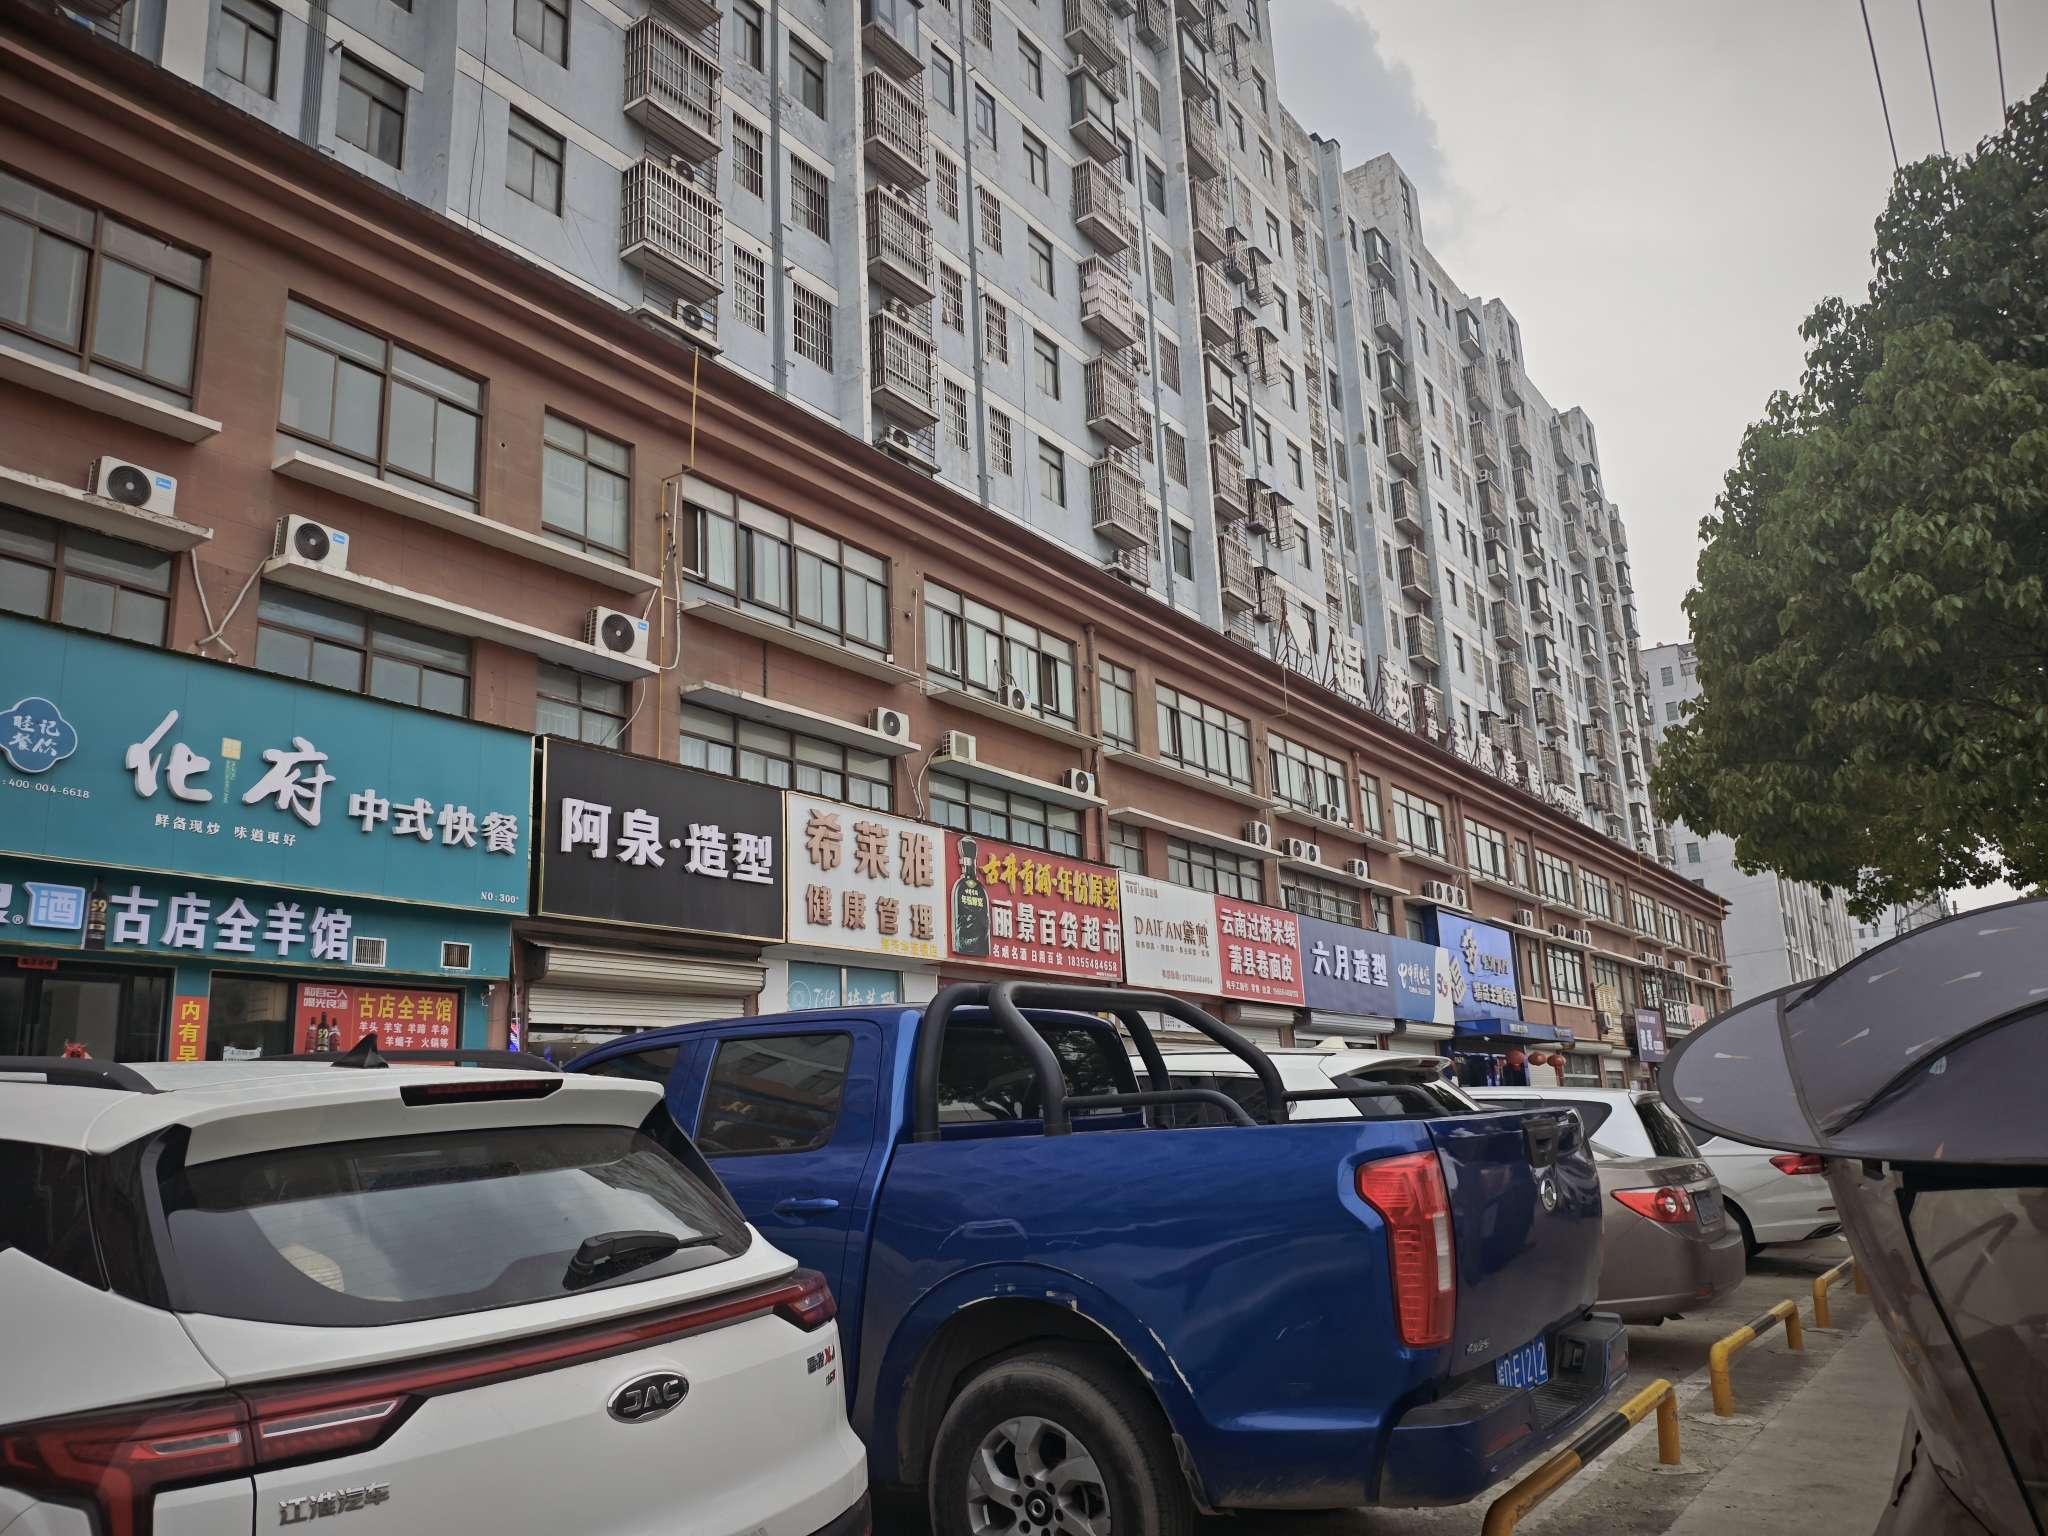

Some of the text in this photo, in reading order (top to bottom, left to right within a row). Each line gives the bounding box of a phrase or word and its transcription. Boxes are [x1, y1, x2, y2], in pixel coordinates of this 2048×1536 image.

[234, 826, 297, 847] 味道更好
[348, 789, 519, 856] 中式快餐
[561, 797, 774, 885] 阿泉·造型
[806, 808, 934, 888] 希莱雅
[38, 889, 77, 924] 酒
[109, 885, 352, 962] 古店全羊馆
[806, 884, 934, 941] 健康管理
[991, 899, 1120, 955] 丽景百货超市
[1219, 907, 1297, 950] 云南过桥米线
[993, 943, 1028, 961] 名烟名酒
[1031, 951, 1063, 966] 日用百货
[1311, 940, 1389, 988] 六月造型
[358, 993, 453, 1022] 古店全羊馆
[359, 1022, 379, 1032] 羊头
[279, 1482, 391, 1527] 江淮汽车
